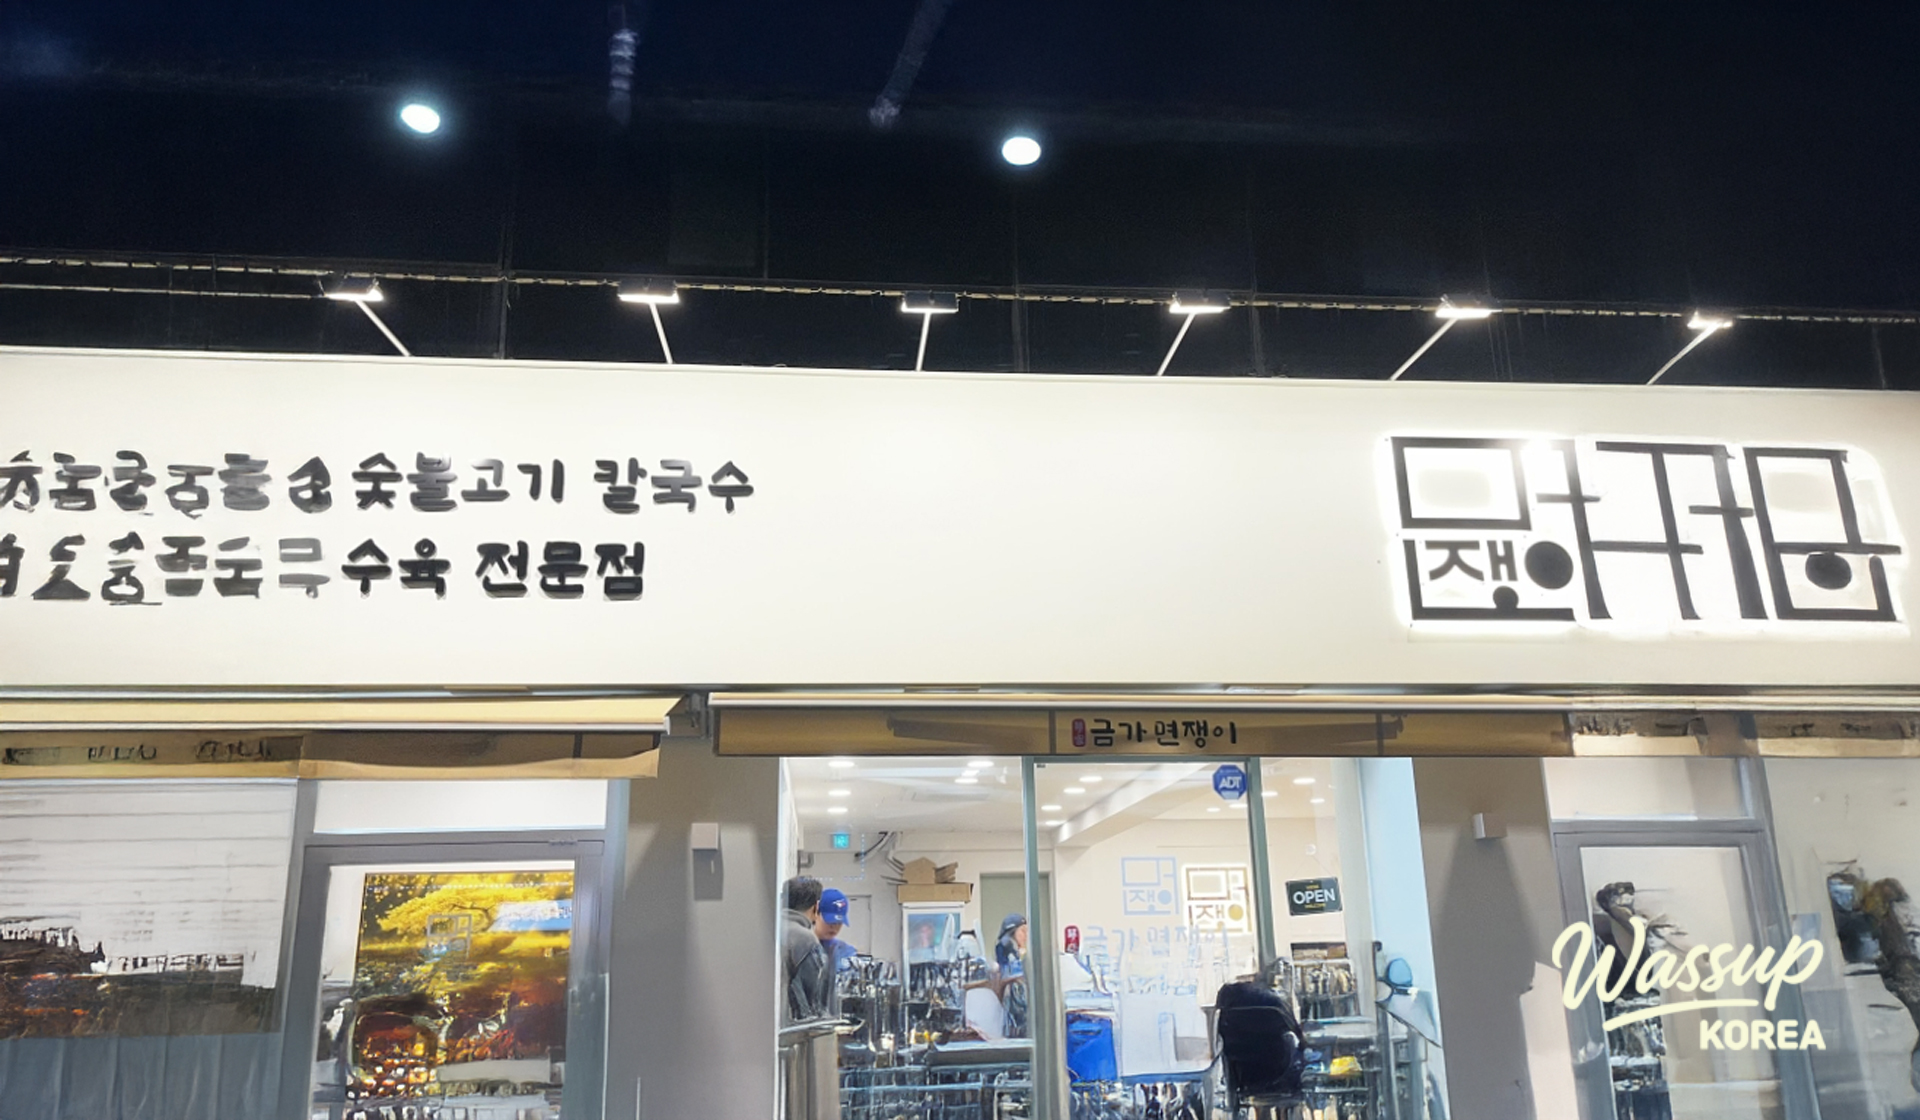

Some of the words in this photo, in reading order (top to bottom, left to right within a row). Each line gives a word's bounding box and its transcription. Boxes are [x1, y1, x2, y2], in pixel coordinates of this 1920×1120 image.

[351, 451, 565, 513] 숯불고기
[593, 457, 755, 515] 칼국수
[341, 538, 451, 599] 수육
[475, 540, 645, 602] 전문점
[1218, 775, 1242, 789] ADT
[1293, 887, 1336, 905] OPEN
